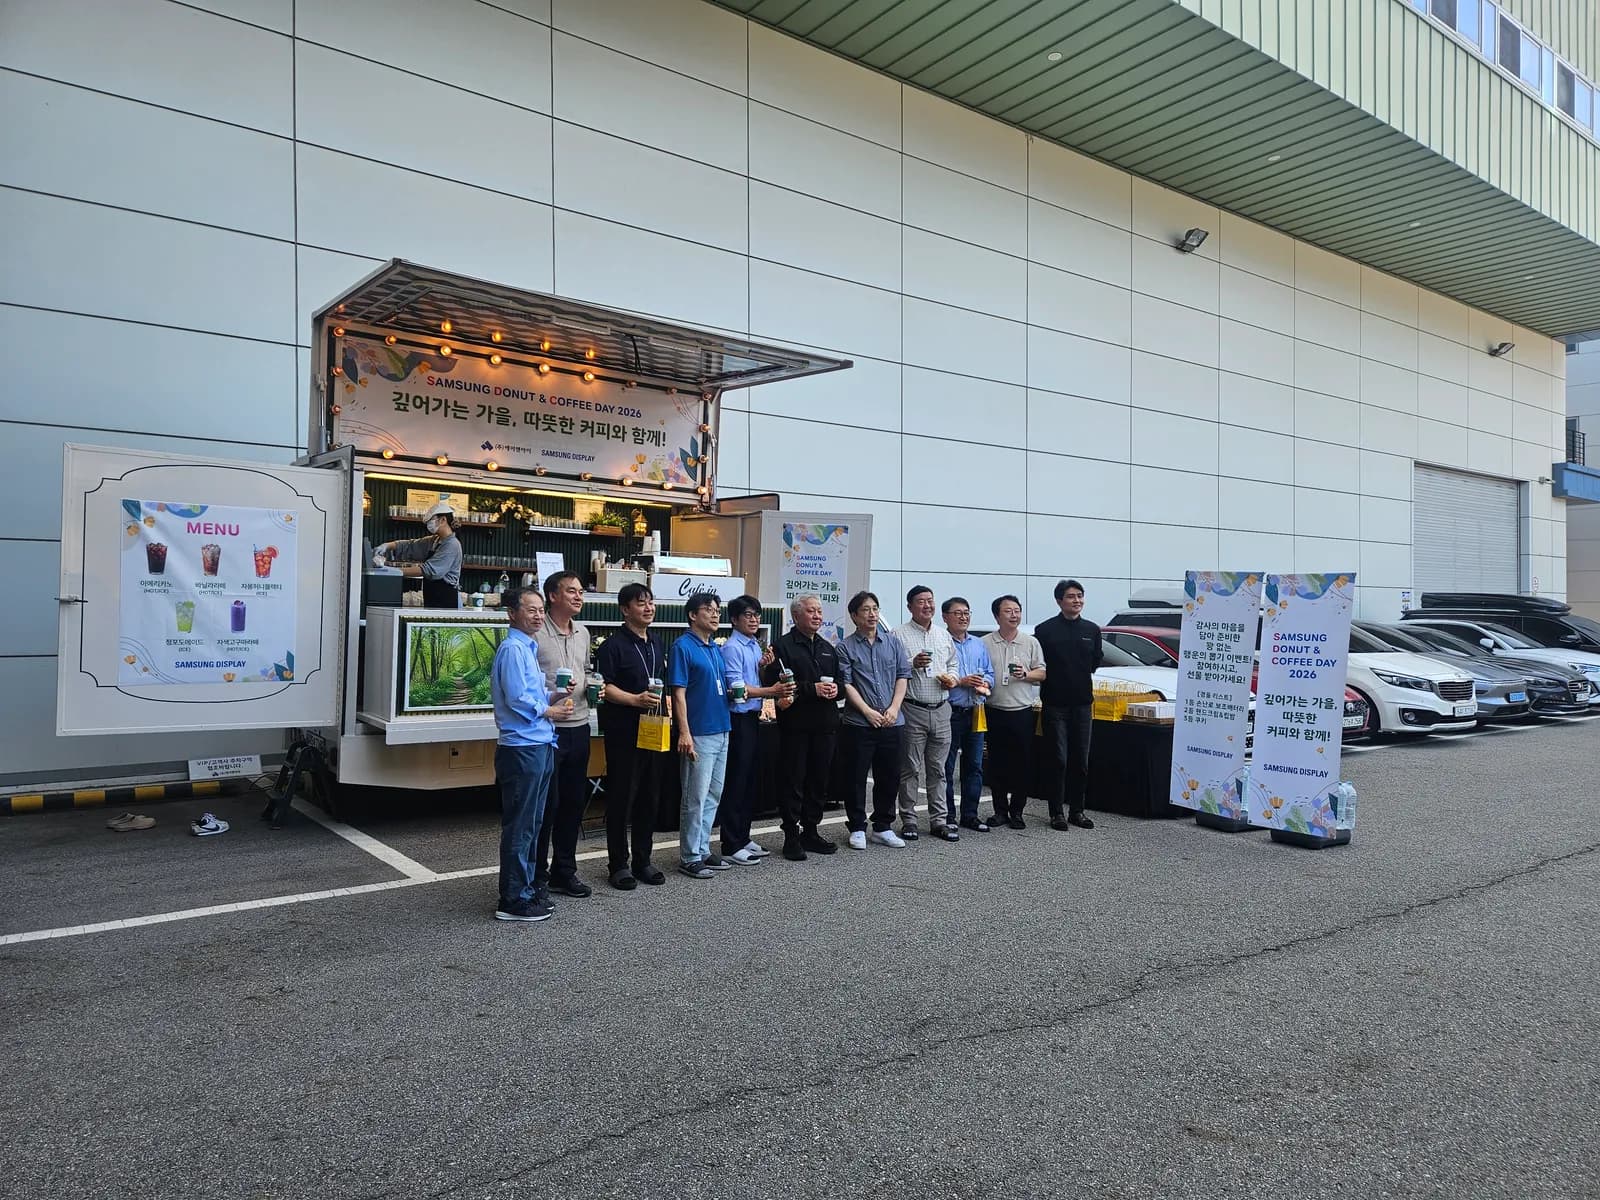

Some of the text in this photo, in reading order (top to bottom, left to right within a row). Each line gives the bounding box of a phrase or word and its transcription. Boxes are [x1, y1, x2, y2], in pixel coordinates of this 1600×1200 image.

[427, 376, 642, 418] SAMSUNG DONUT & COFFEE DAY 2026
[392, 391, 666, 447] 깊어가는 가을, 따뜻한 커피와 함께!
[541, 449, 595, 462] SAMSUNG DISPLAY
[187, 522, 240, 536] MENU
[786, 580, 819, 590] 깊어가는
[819, 593, 839, 603] 피와
[1196, 621, 1245, 632] 감사의 마음을
[1199, 631, 1240, 642] 담아 준비한
[1273, 632, 1327, 642] SAMSUNG
[1215, 642, 1231, 652] 없는
[1273, 645, 1321, 655] DONUT &
[1184, 650, 1207, 660] 행운의
[216, 660, 246, 668] DISPLAY
[1197, 661, 1237, 673] 참여하시고,
[1272, 657, 1337, 668] COFFEE DAY
[1187, 670, 1246, 684] 선물 받아가세요!
[1289, 669, 1317, 679] 2026
[1264, 693, 1338, 710] 깊어가는 가을,
[1282, 711, 1317, 724] 따뜻한
[1267, 726, 1331, 742] 커피와 함께!
[1187, 745, 1233, 759] SAMSUNG DISPLAY
[1263, 763, 1329, 778] SAMSUNG DISPLAY
